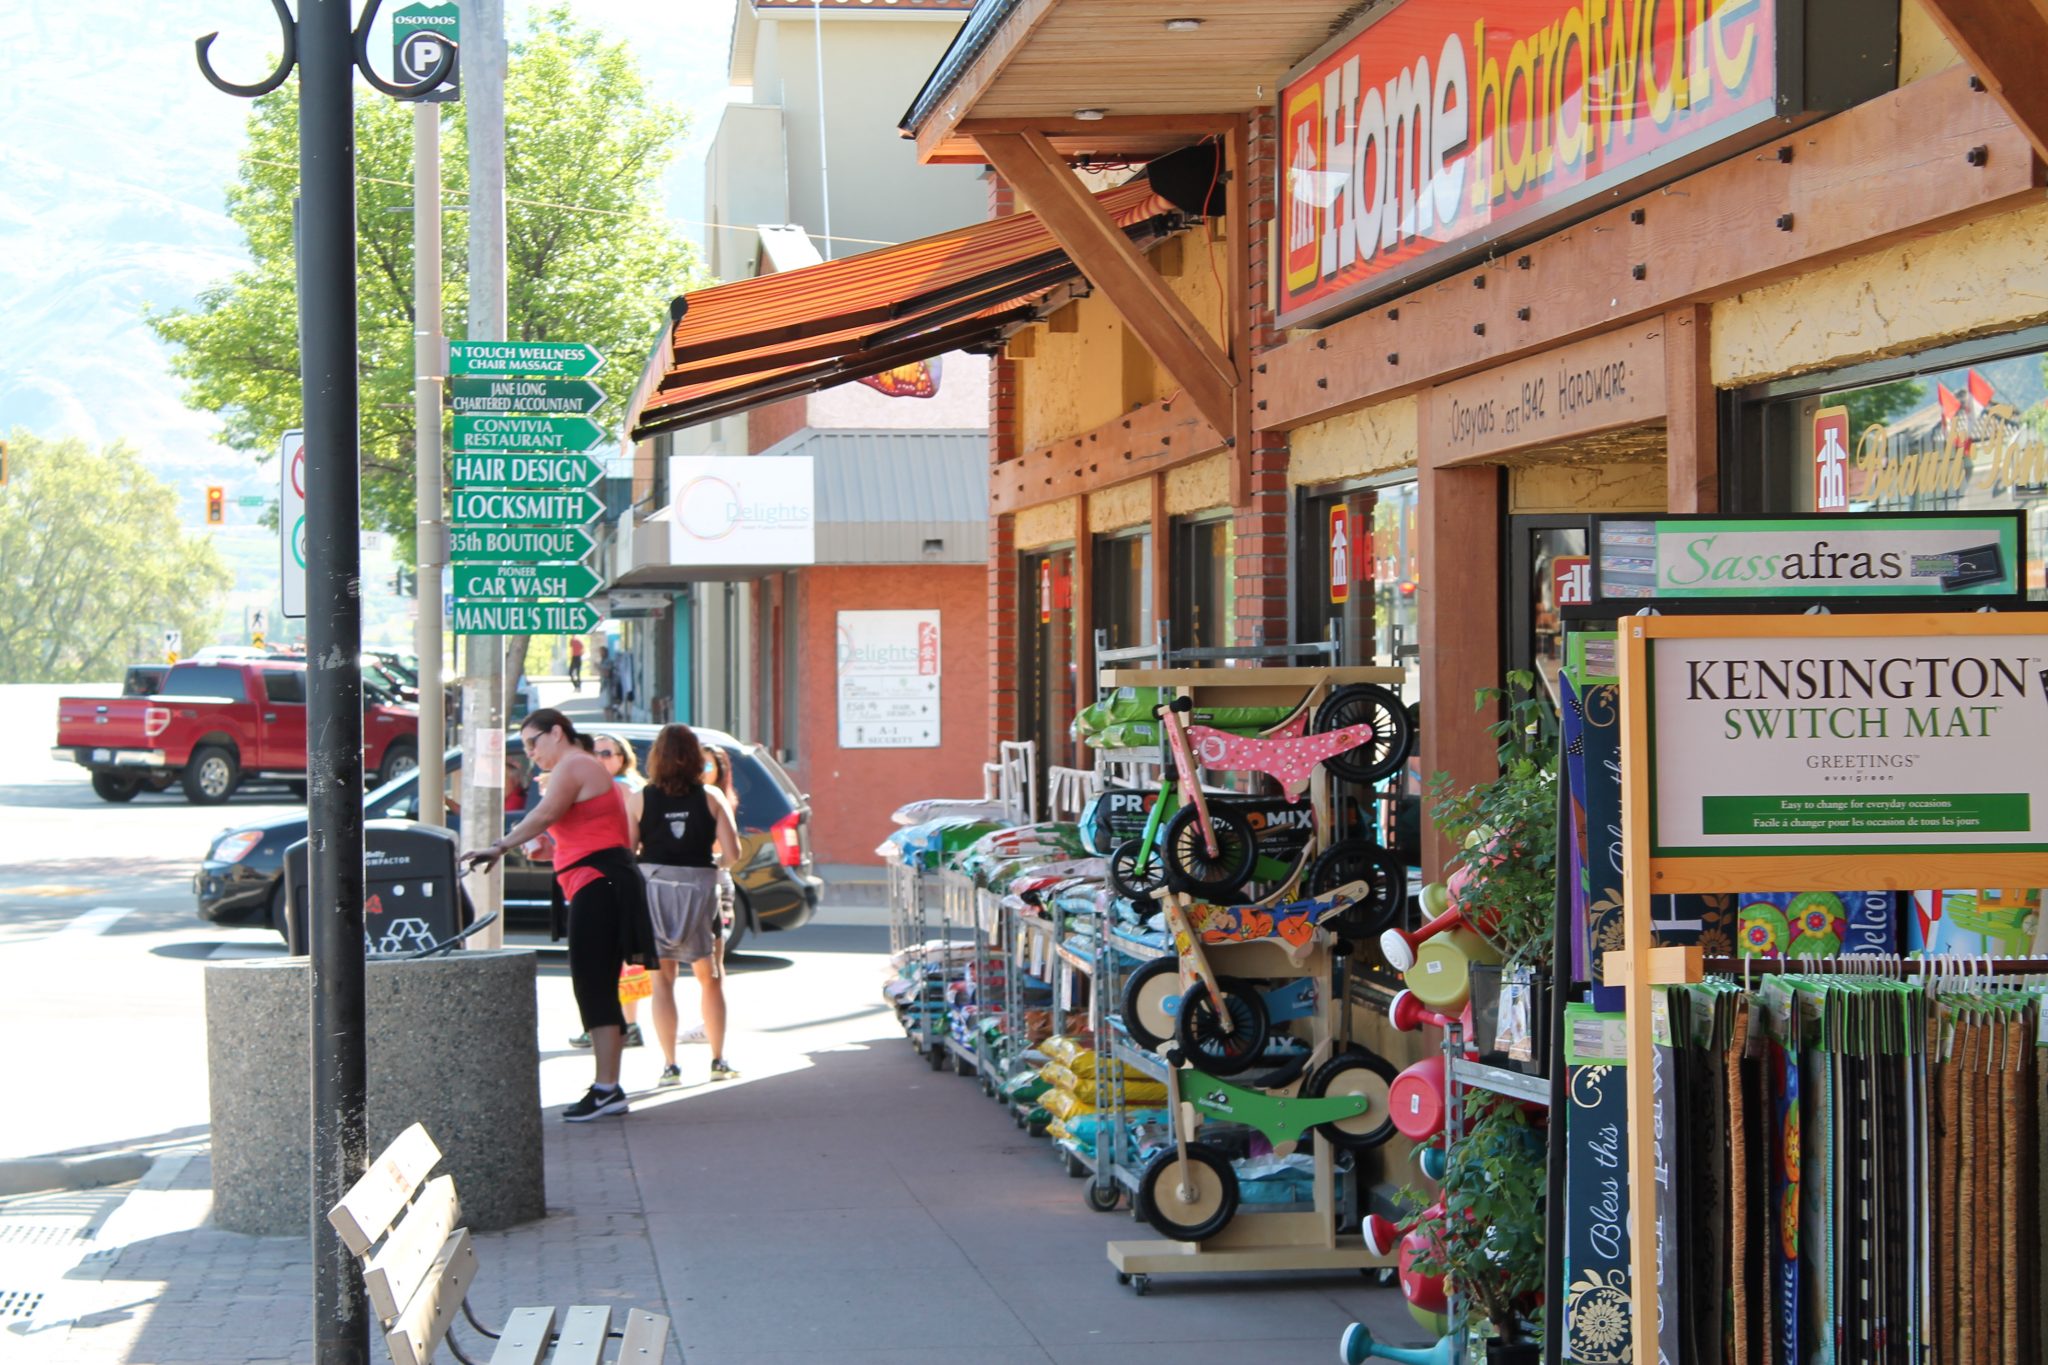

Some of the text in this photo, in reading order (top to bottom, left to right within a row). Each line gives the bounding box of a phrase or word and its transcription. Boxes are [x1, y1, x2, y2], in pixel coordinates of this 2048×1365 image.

[394, 15, 457, 25] OSOYOOS
[413, 41, 442, 72] P
[1320, 0, 1758, 278] Home hardware
[450, 346, 586, 360] N TOUCH WELLNESS
[468, 359, 564, 371] CHAIR MASSAGE
[491, 382, 547, 396] JANE LONG
[453, 396, 583, 411] CHARTERED ACCOUNTANT
[1521, 377, 1545, 424] 1942
[473, 419, 553, 433] CONVIVIA
[464, 434, 564, 447] RESTAURANT
[455, 458, 587, 482] HAIR DESIGN
[456, 495, 583, 519] LOCKSMITH
[726, 502, 811, 524] Delights
[486, 533, 574, 556] BOUTIQUE
[1666, 534, 1903, 586] Sassafras
[498, 567, 537, 576] PIONEER
[468, 577, 568, 596] CAR WASH
[455, 607, 588, 630] MANUEL'S TILES
[839, 643, 919, 665] Delights
[1685, 657, 2030, 700] KENSINGTON
[1724, 705, 1998, 741] SWITCH MAT
[1806, 754, 1914, 769] GREETINGS
[1824, 774, 1894, 783] evergreen
[1781, 798, 1952, 811] Easy to change for everyday occasions
[1753, 818, 1780, 828] Facile
[1790, 818, 1826, 829] changer
[1828, 819, 1850, 829] pour
[1852, 817, 1864, 827] les
[1866, 817, 1906, 827] occasion
[1907, 817, 1919, 826] de
[1920, 818, 1941, 827] tous
[1942, 817, 1955, 826] les
[1956, 817, 1980, 828] jours
[365, 856, 410, 867] OMPACTOR
[1588, 1122, 1622, 1259] Bless this
